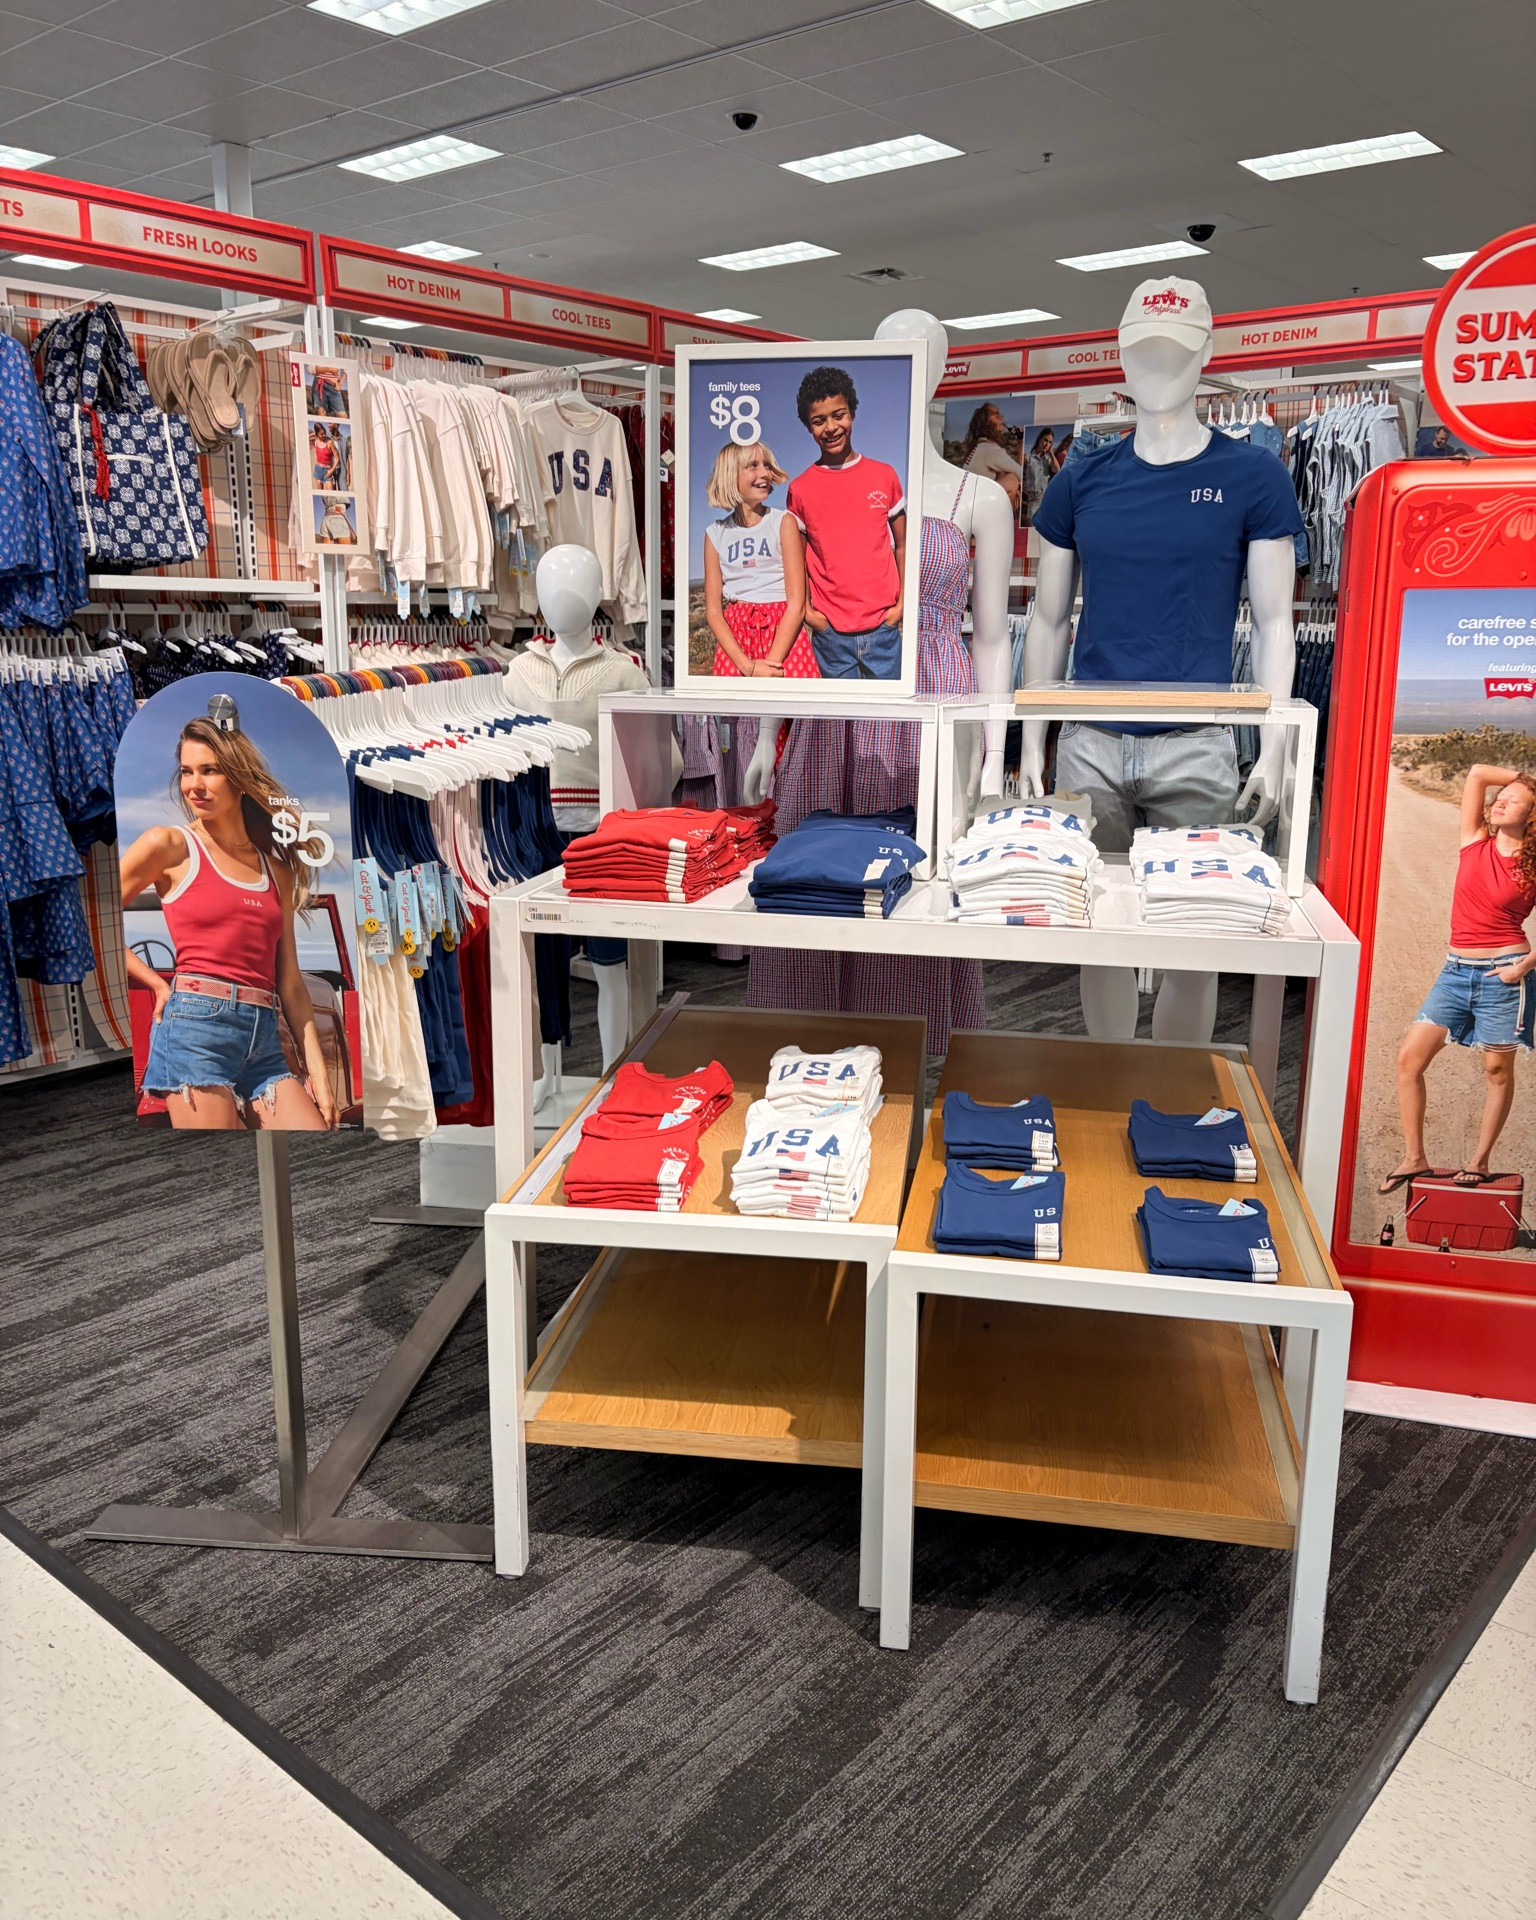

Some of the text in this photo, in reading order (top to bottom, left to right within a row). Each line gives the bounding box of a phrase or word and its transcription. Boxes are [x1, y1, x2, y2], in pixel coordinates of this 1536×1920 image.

[143, 226, 257, 262] FRESH LOOKS
[387, 275, 461, 301] HOT DENIM
[552, 308, 611, 330] COOL TEES
[1241, 326, 1318, 346] HOT DENIM
[1068, 352, 1099, 364] COOL
[708, 381, 761, 394] family tees
[710, 394, 761, 446] $8
[548, 449, 613, 503] USA
[1191, 488, 1223, 503] USA
[728, 537, 772, 563] USA
[1458, 616, 1526, 629] carefree
[1446, 633, 1536, 649] for the ope
[1488, 663, 1536, 673] featuring
[268, 795, 299, 806] tanks
[271, 808, 334, 868] $5
[1143, 858, 1277, 890] USA
[779, 1061, 857, 1081] USA
[1023, 1118, 1053, 1128] USA
[747, 1128, 840, 1157] USA
[1033, 1207, 1057, 1218] US
